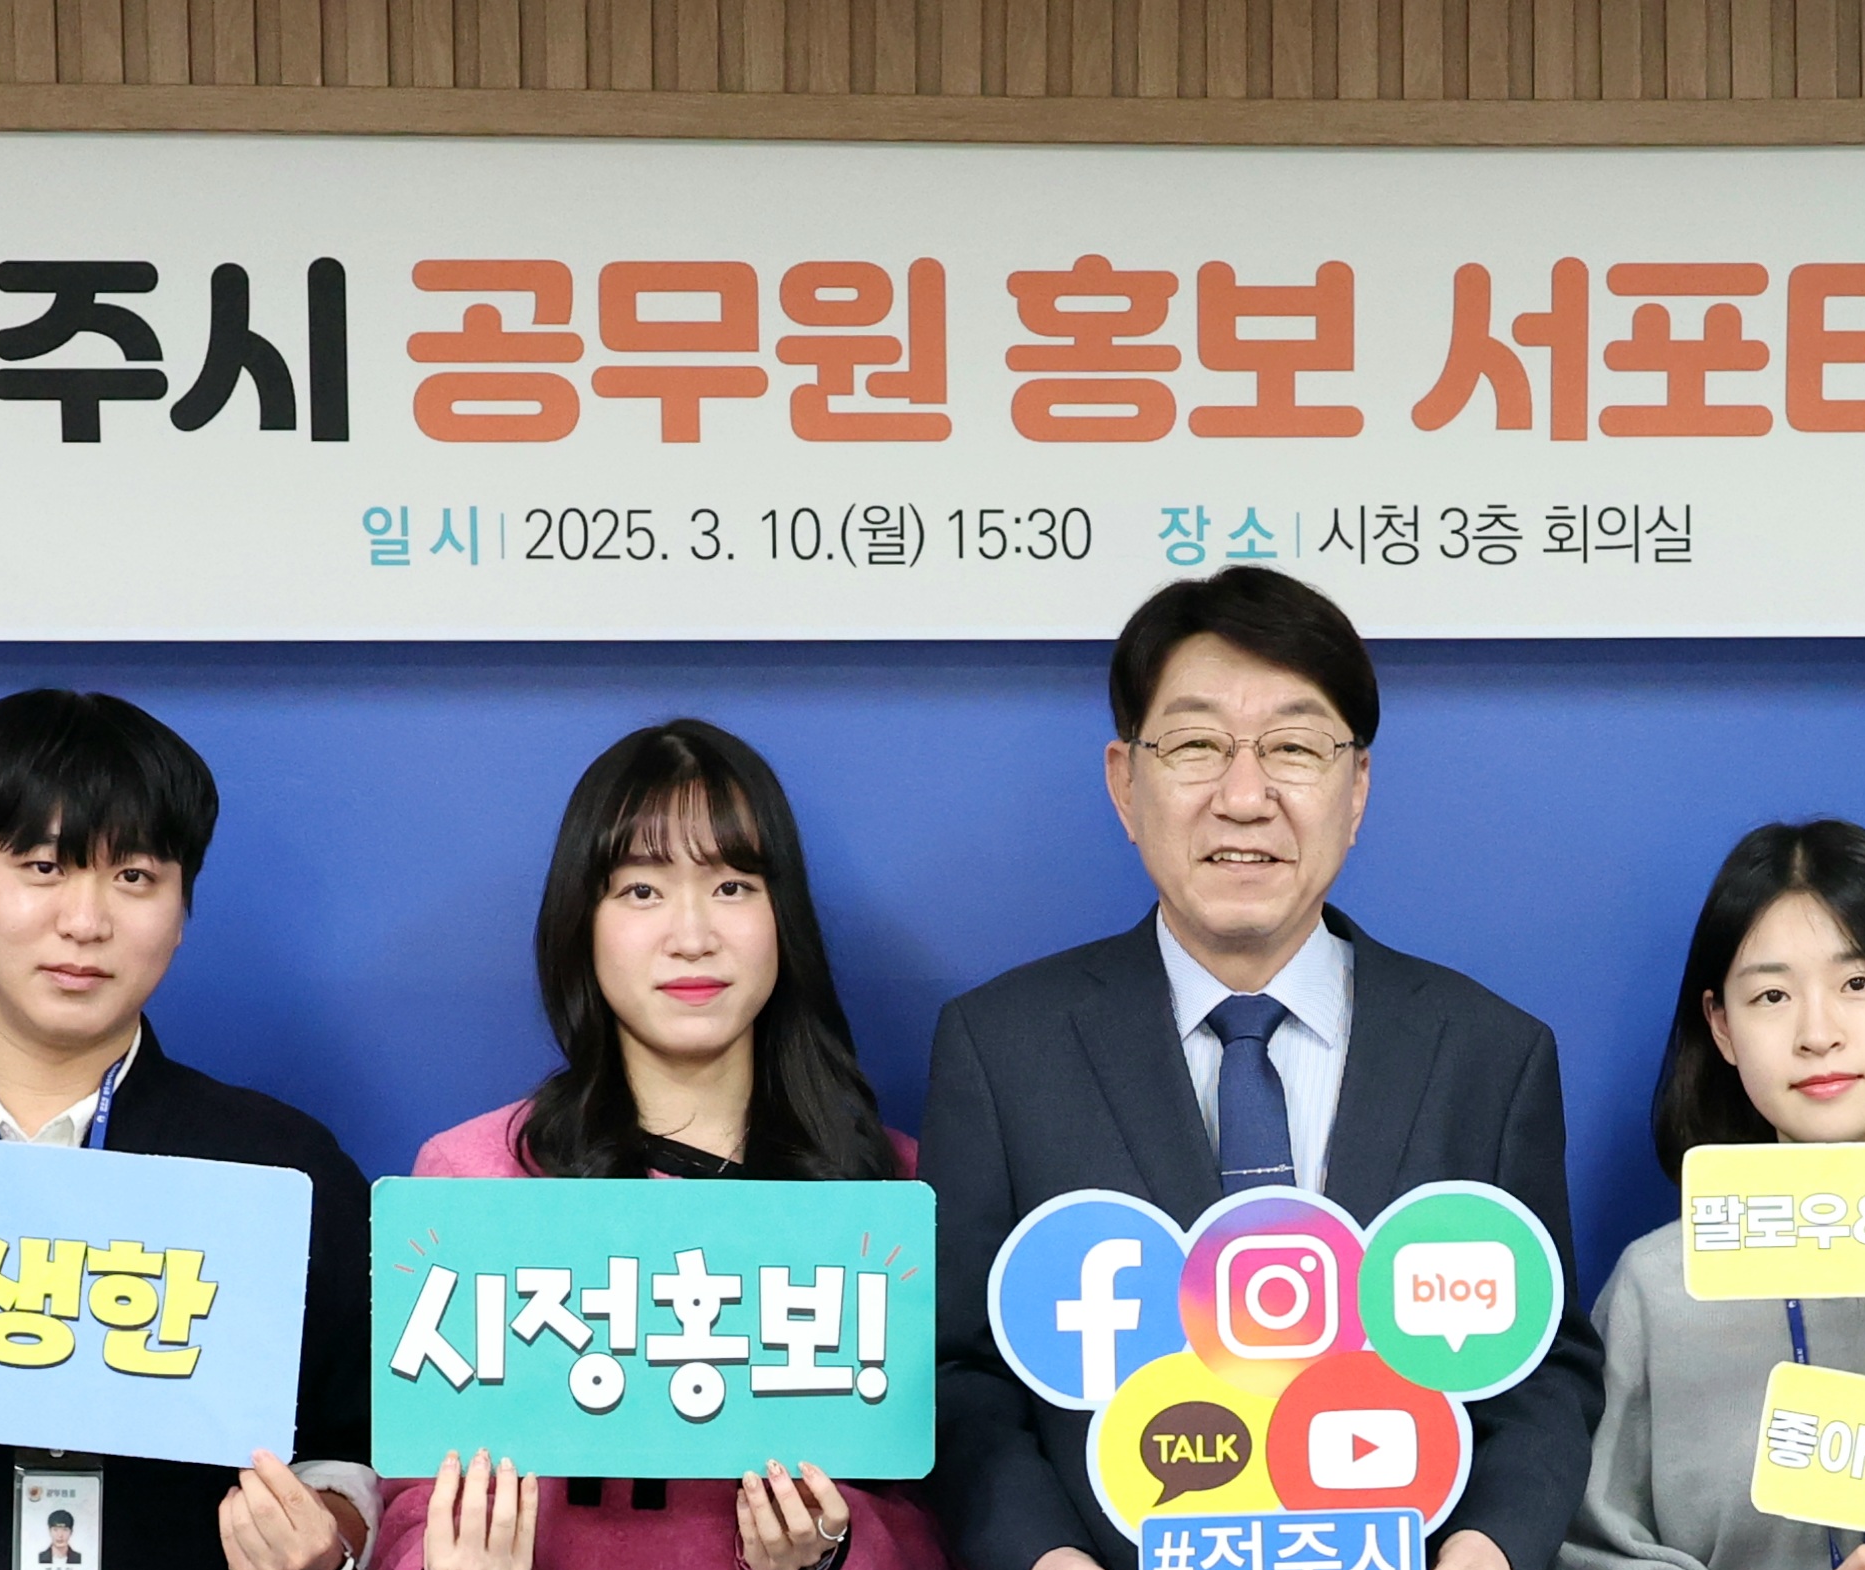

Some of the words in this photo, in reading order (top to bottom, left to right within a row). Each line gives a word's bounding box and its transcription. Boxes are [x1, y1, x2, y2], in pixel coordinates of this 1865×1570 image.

[405, 256, 953, 443] 공무원
[1002, 253, 1365, 443] 홍보
[524, 507, 669, 561] 2025.
[690, 507, 735, 561] 3.
[947, 506, 1092, 561] 15:30
[1317, 504, 1420, 566] 시청
[1439, 504, 1524, 566] 3층
[1542, 503, 1693, 565] 회의실
[1411, 1273, 1498, 1310] blog
[388, 1246, 889, 1424] 시정홍보!
[1151, 1433, 1240, 1466] TALK
